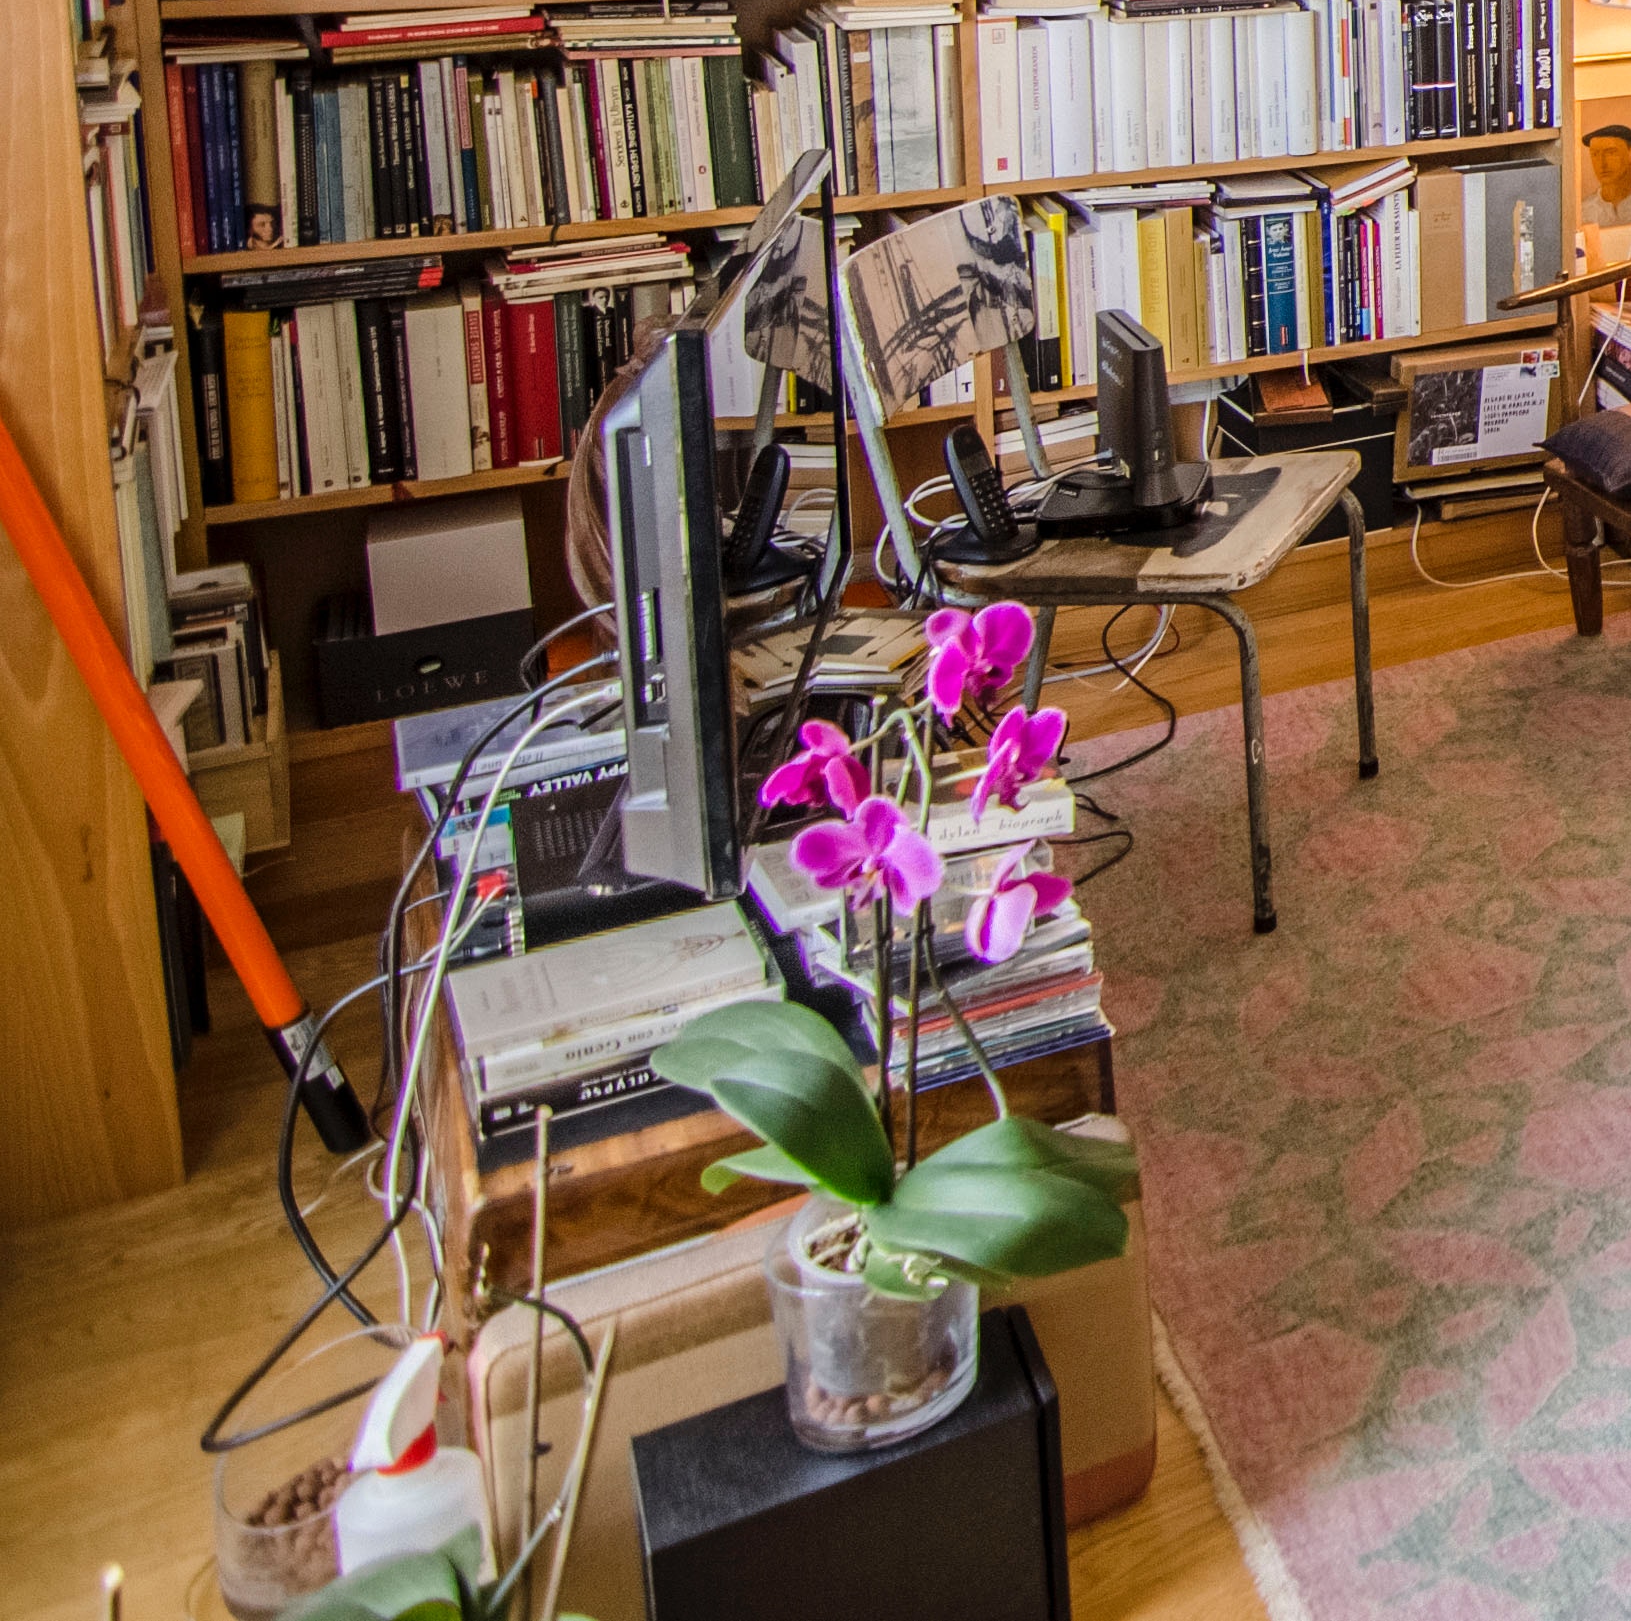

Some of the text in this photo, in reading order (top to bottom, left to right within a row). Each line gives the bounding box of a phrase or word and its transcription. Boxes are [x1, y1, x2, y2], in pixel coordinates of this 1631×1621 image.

[624, 103, 640, 187] KATHARINE HEPBURN
[376, 670, 490, 700] LOEWE
[527, 770, 593, 798] VALLEY
[938, 824, 980, 841] dylan
[565, 1040, 621, 1060] Genio
